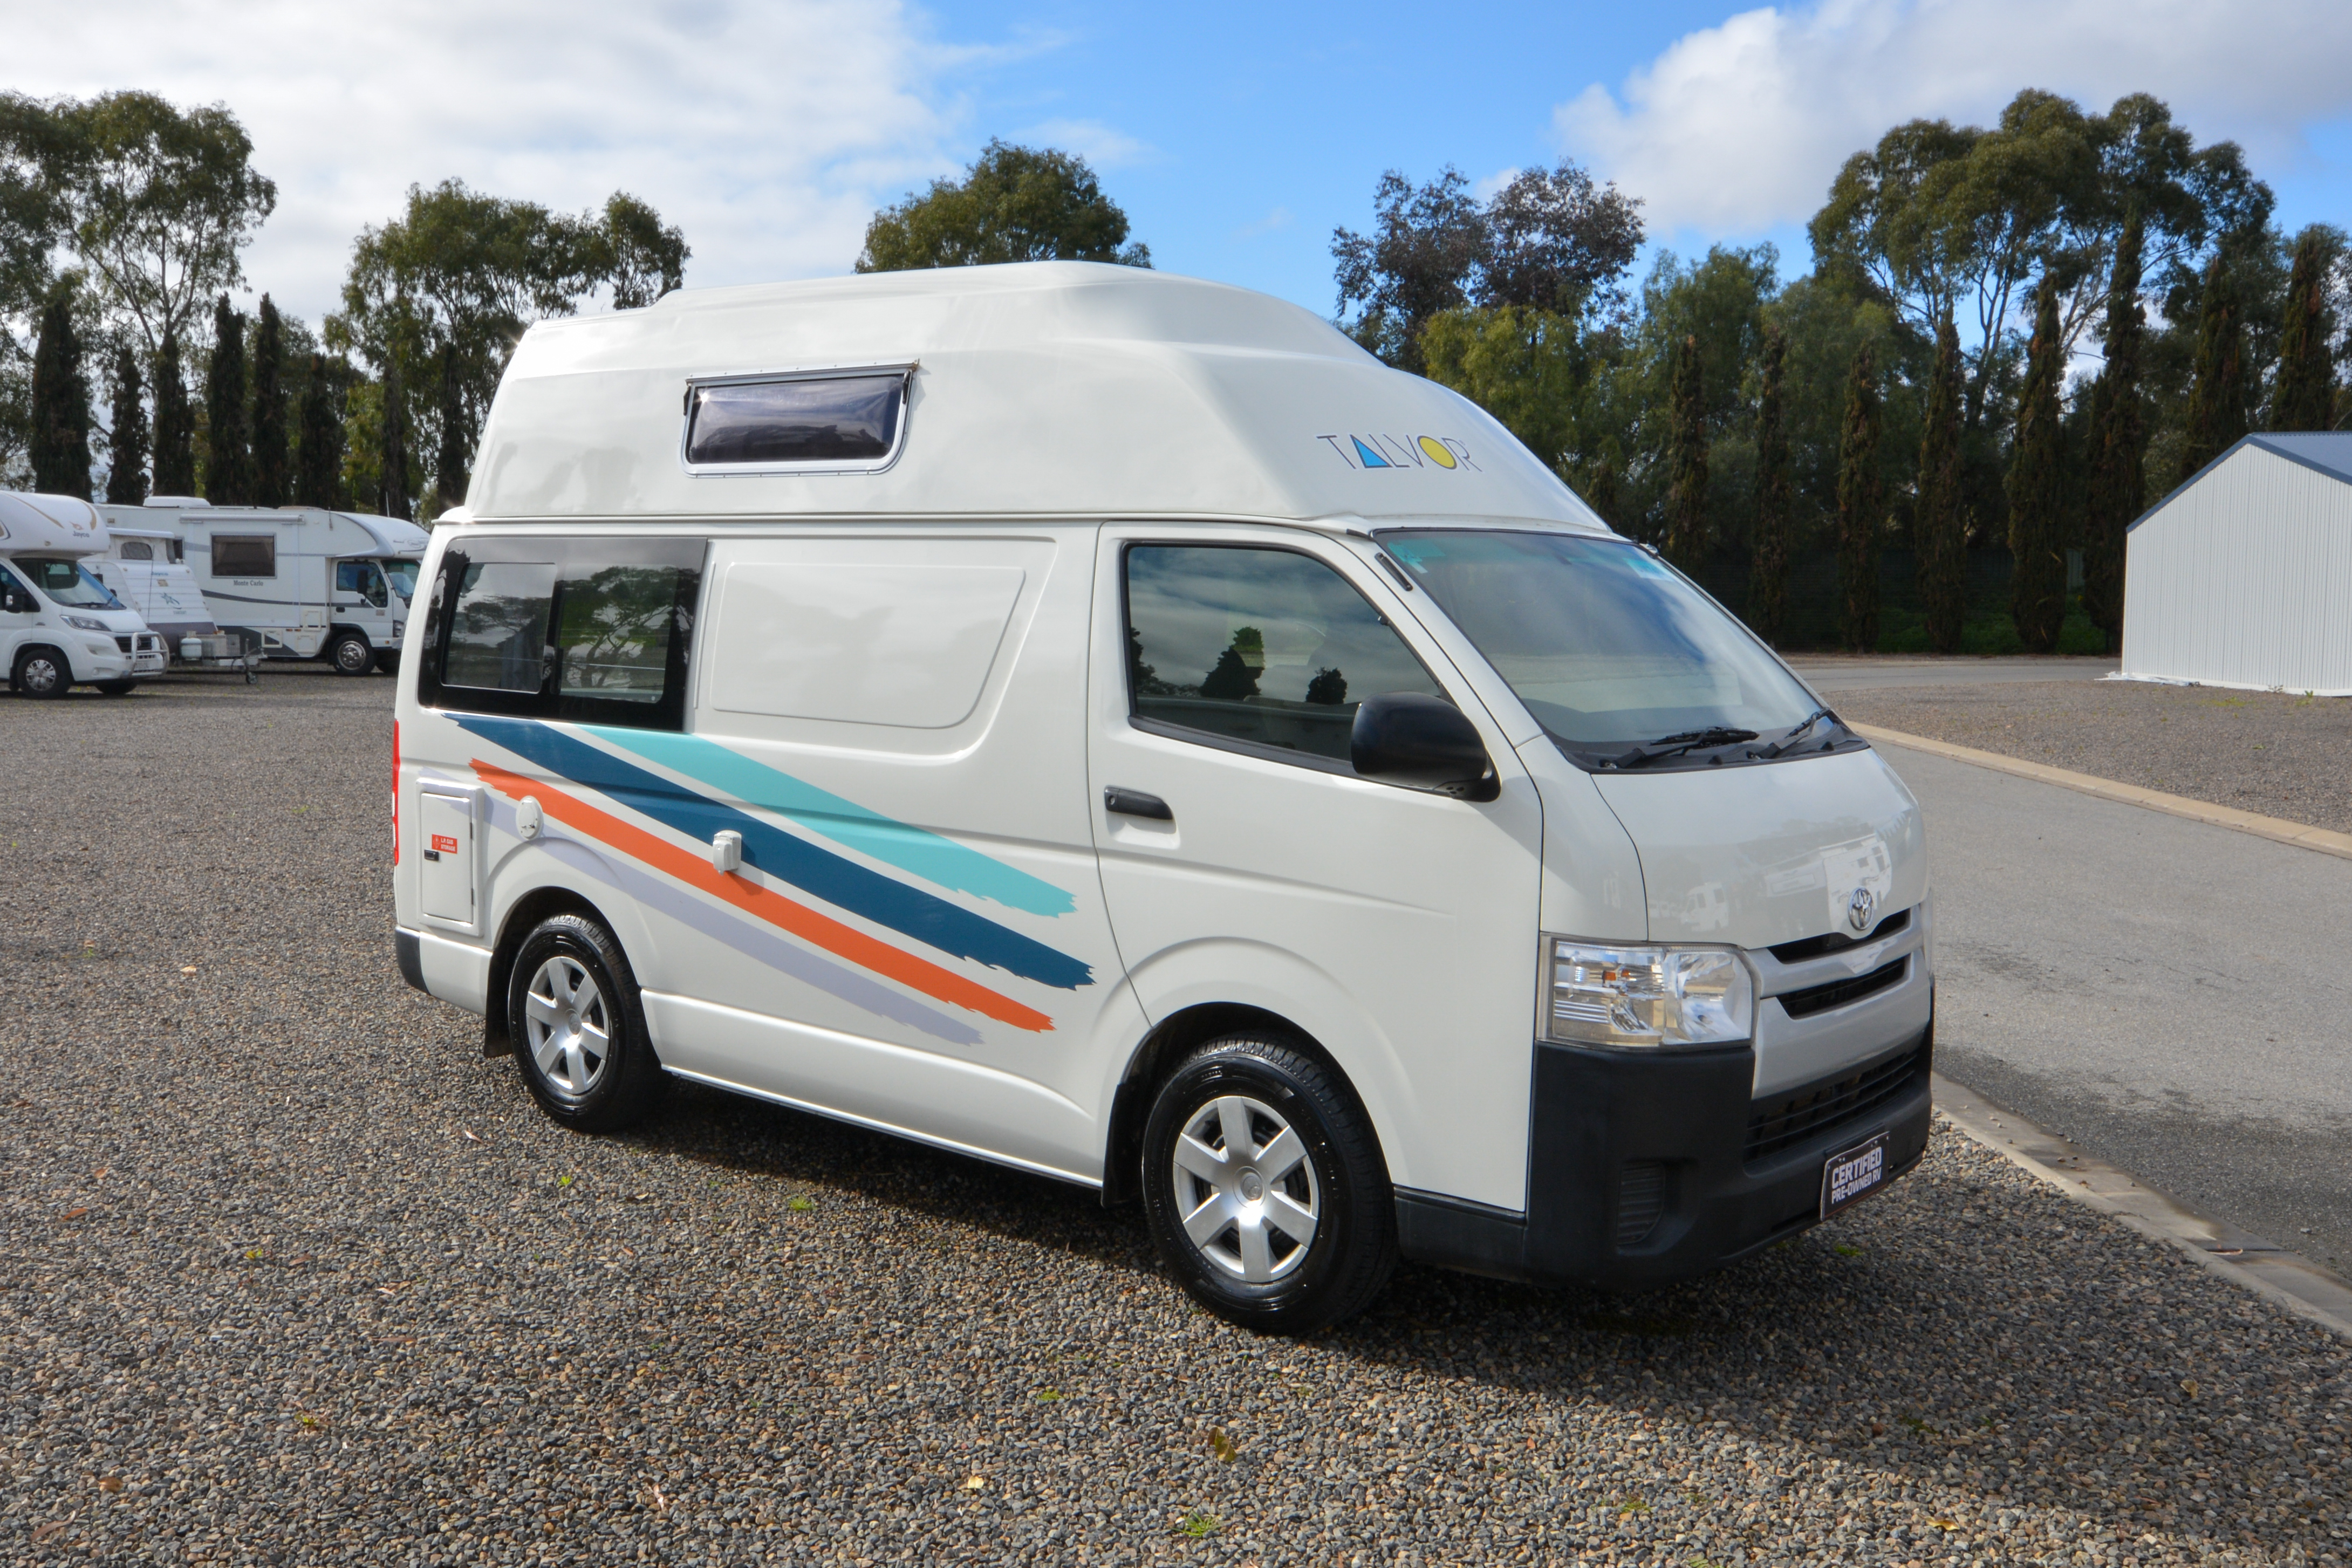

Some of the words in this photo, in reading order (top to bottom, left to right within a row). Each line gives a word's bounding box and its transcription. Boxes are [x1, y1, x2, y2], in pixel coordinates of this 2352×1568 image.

[1316, 433, 1482, 472] TALVOR
[1831, 1172, 1872, 1204] PRE-OWNED
[1872, 1167, 1882, 1183] RV
[1832, 1146, 1882, 1189] CERTIFIED
